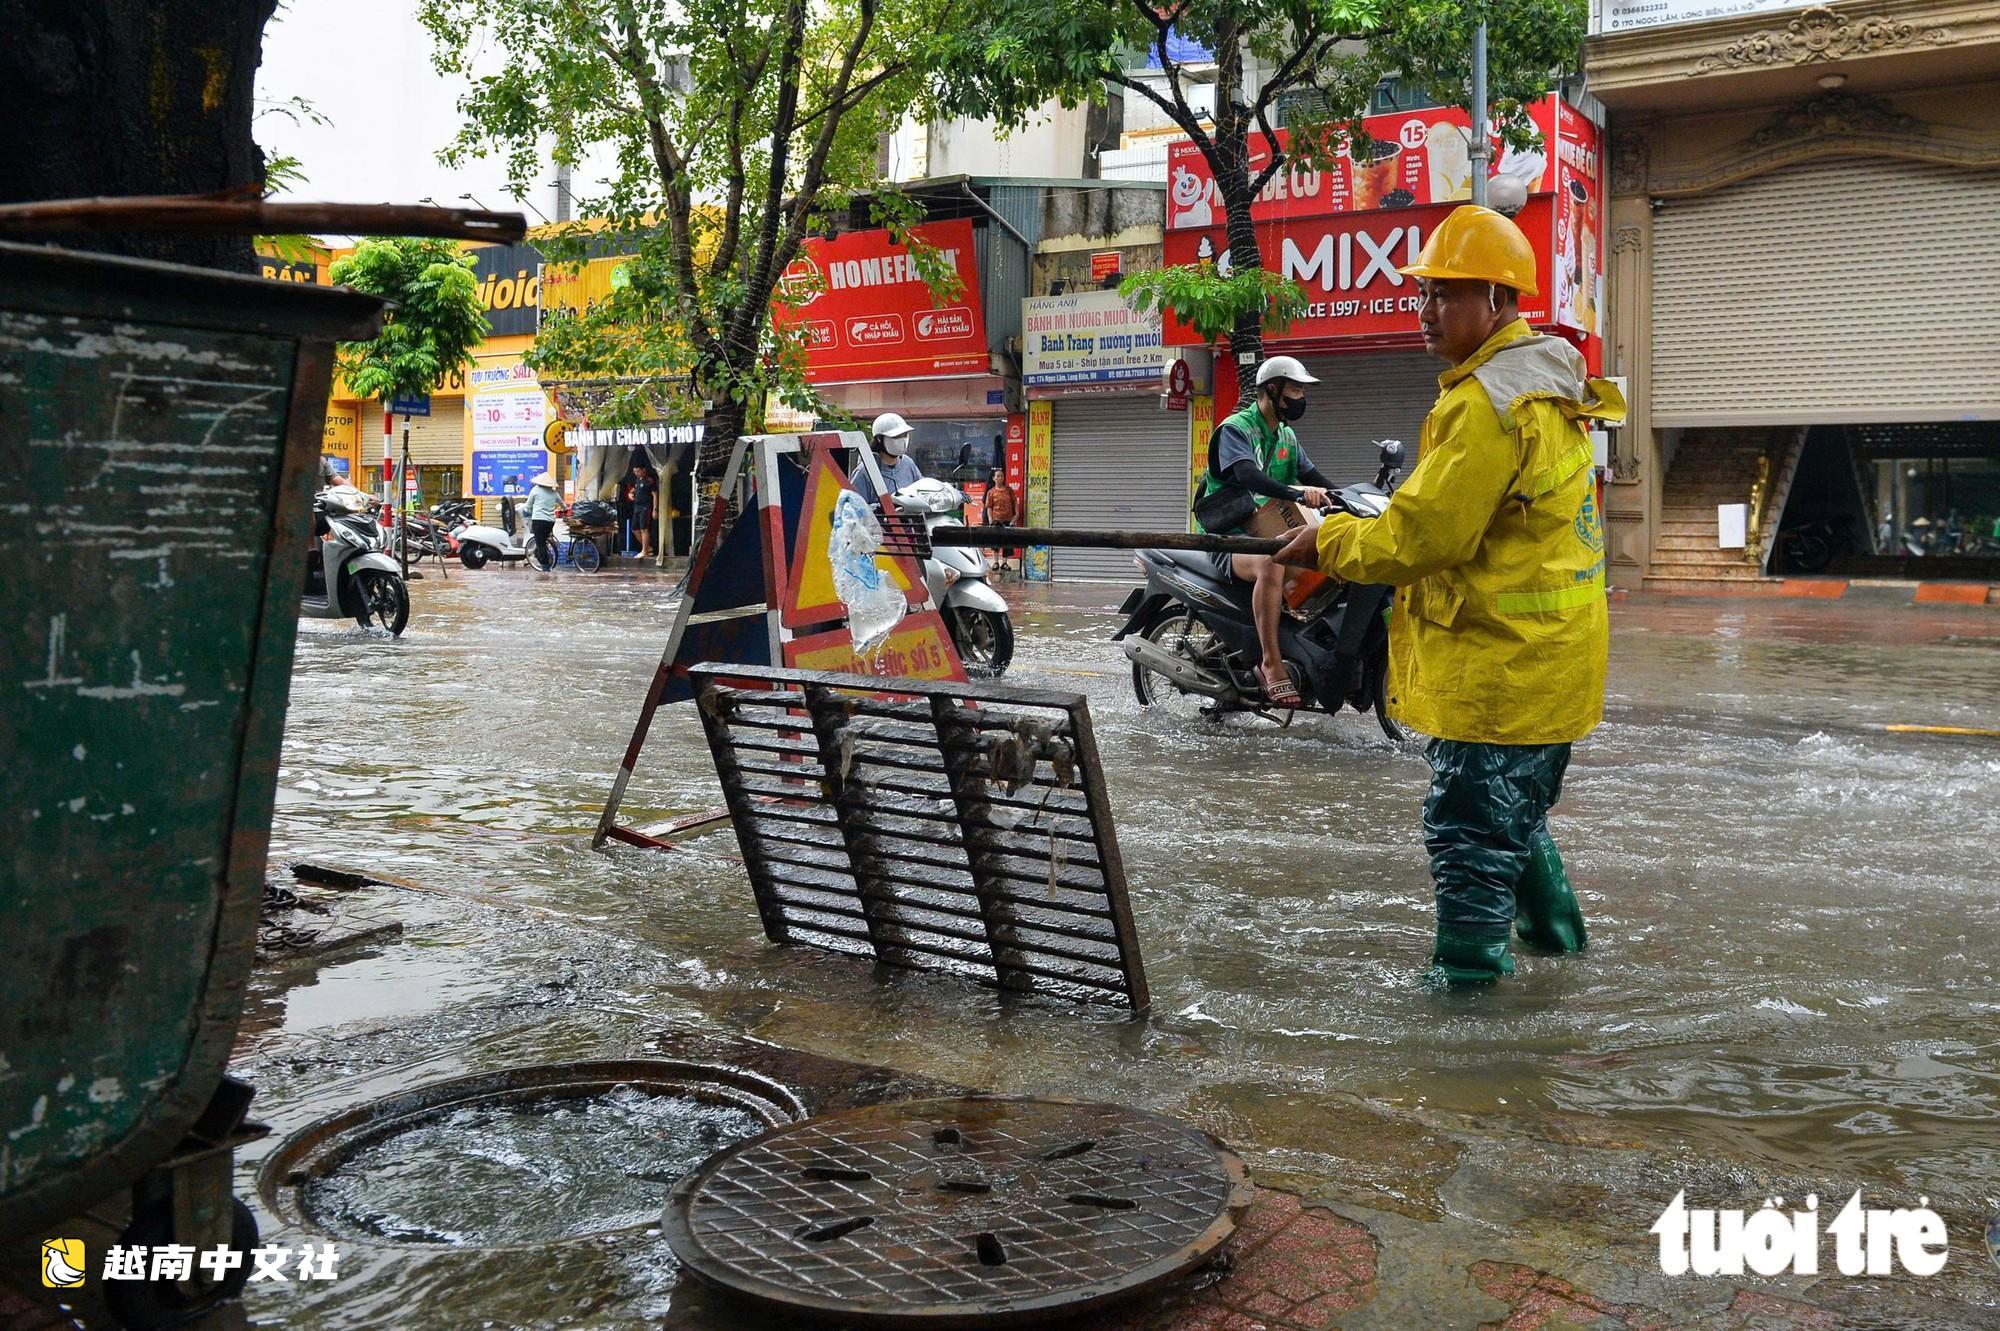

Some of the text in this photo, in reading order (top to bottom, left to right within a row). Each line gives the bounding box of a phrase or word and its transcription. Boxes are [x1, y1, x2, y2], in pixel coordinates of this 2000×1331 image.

[829, 249, 957, 290] HOMEFAM
[1330, 300, 1361, 317] 1997
[1370, 297, 1394, 314] ICE
[1398, 296, 1419, 311] CR
[1039, 360, 1055, 370] Mua
[1056, 359, 1061, 369] 5
[1081, 357, 1098, 368] Ship
[1126, 354, 1141, 365] free
[1143, 353, 1148, 364] 2
[1150, 353, 1163, 363] Km
[325, 416, 353, 426] PTOP
[930, 644, 941, 668] 5
